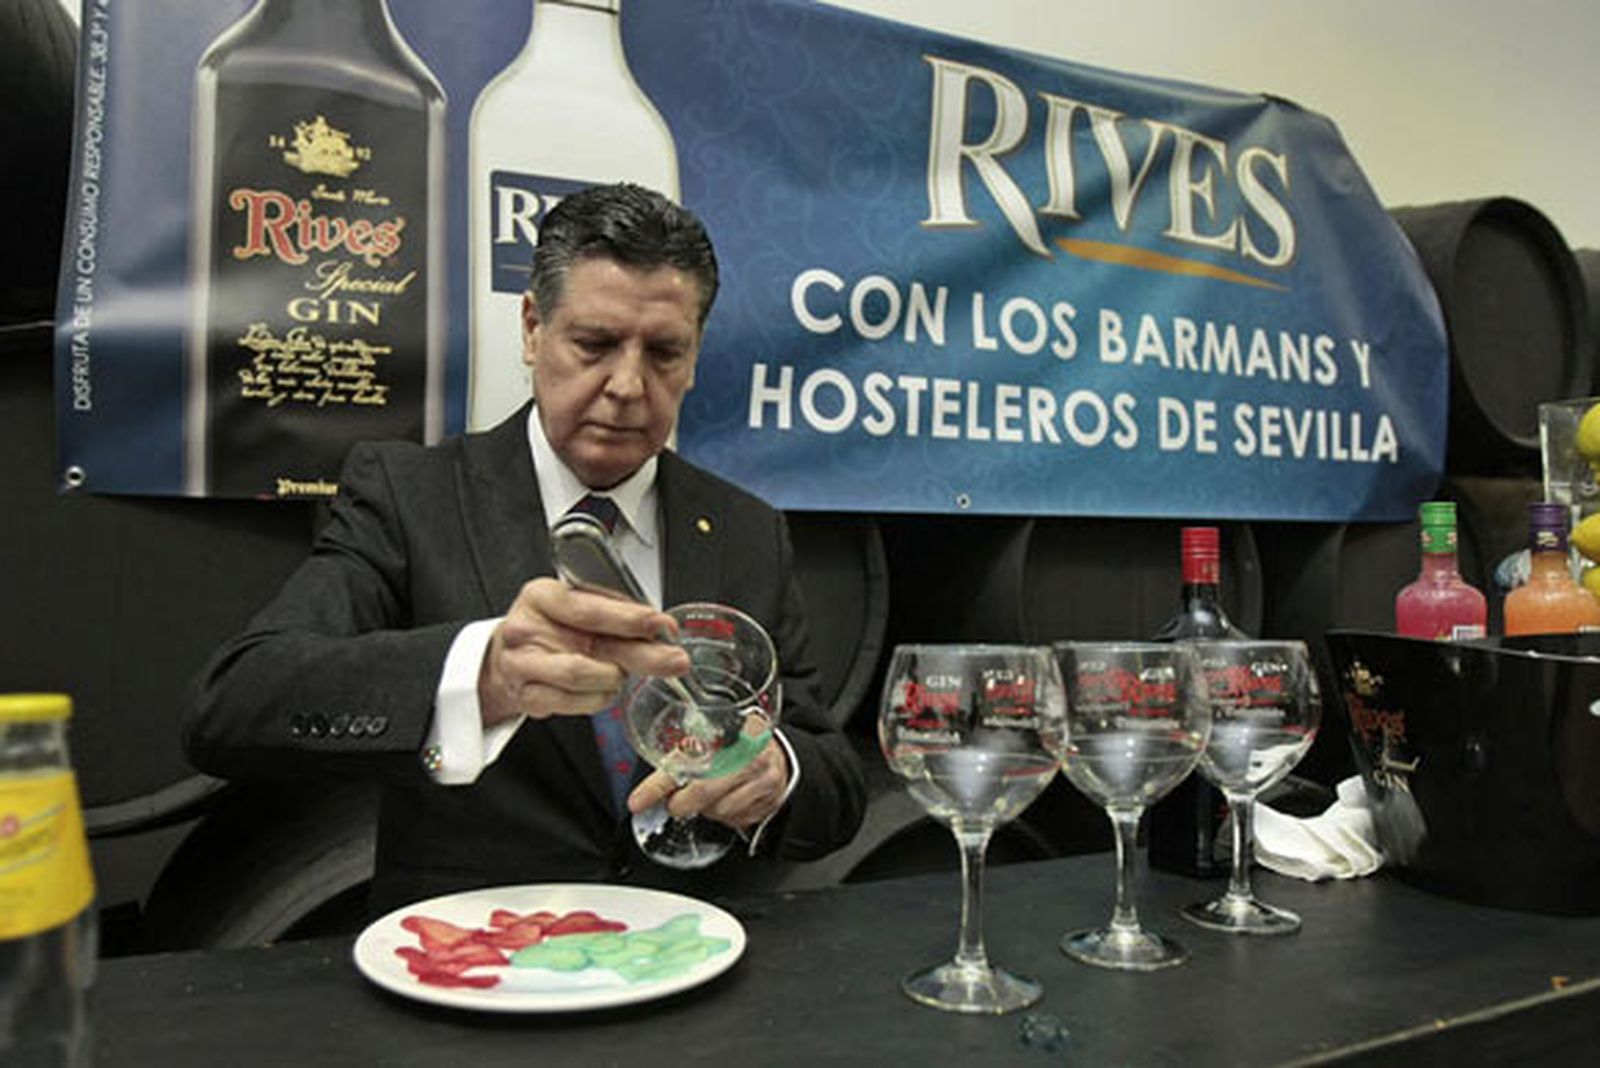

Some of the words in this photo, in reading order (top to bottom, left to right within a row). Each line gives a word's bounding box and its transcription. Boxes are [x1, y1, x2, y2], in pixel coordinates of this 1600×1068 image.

[920, 54, 1297, 267] RIVES
[77, 183, 99, 275] CONSUMO
[229, 188, 406, 266] Rives
[73, 304, 93, 329] DE
[76, 277, 93, 302] UN
[287, 298, 381, 326] GIN
[304, 260, 417, 299] Special
[791, 268, 949, 347] CON
[972, 292, 1078, 361] LOS
[1100, 309, 1336, 386] BARMANS
[1351, 339, 1373, 389] Y
[72, 331, 93, 411] DISFRUTA
[748, 363, 1139, 450] HOSTELEROS
[1159, 397, 1217, 455] DE
[1234, 406, 1399, 464] SEVILLA
